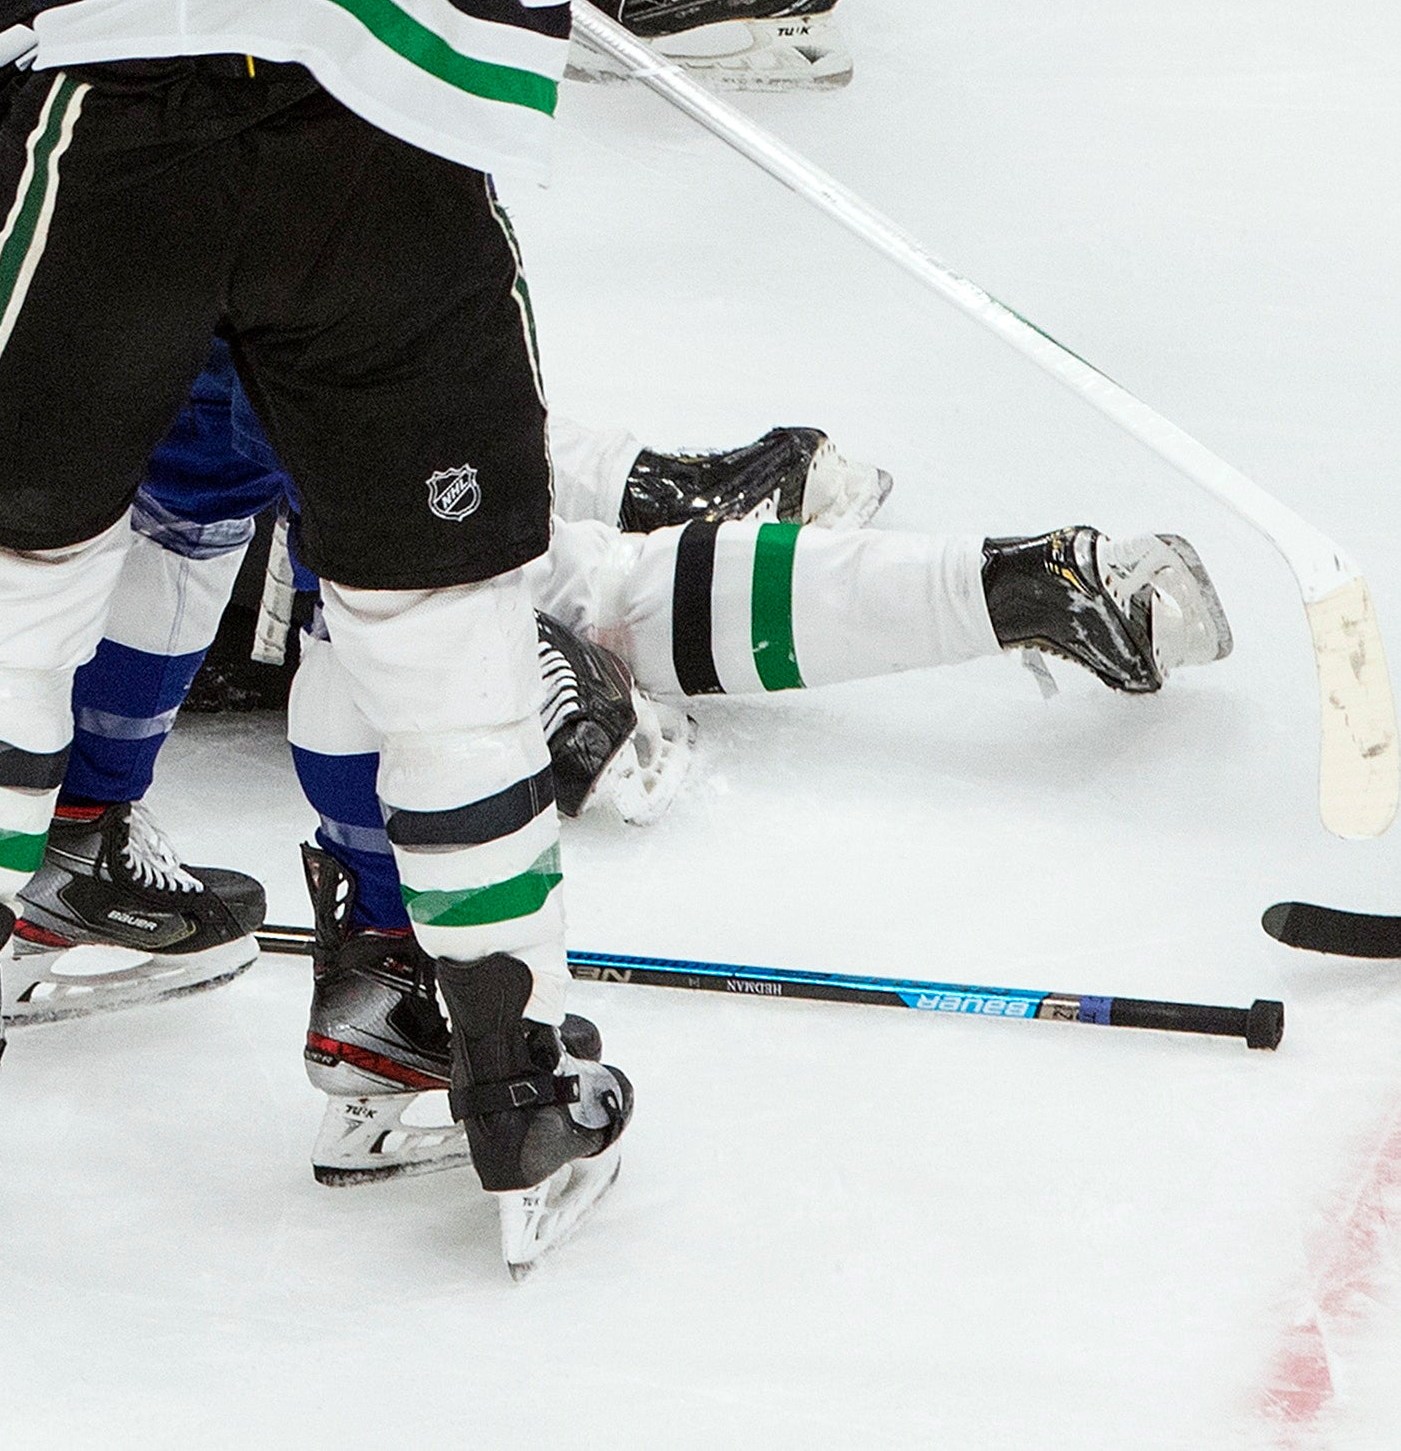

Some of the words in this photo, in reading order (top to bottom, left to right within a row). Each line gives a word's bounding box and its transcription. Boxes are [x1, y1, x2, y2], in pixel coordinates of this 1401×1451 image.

[107, 909, 158, 931] BAUER
[569, 964, 633, 983] NE
[726, 978, 783, 995] HEDMAN
[916, 993, 1030, 1017] BAUER
